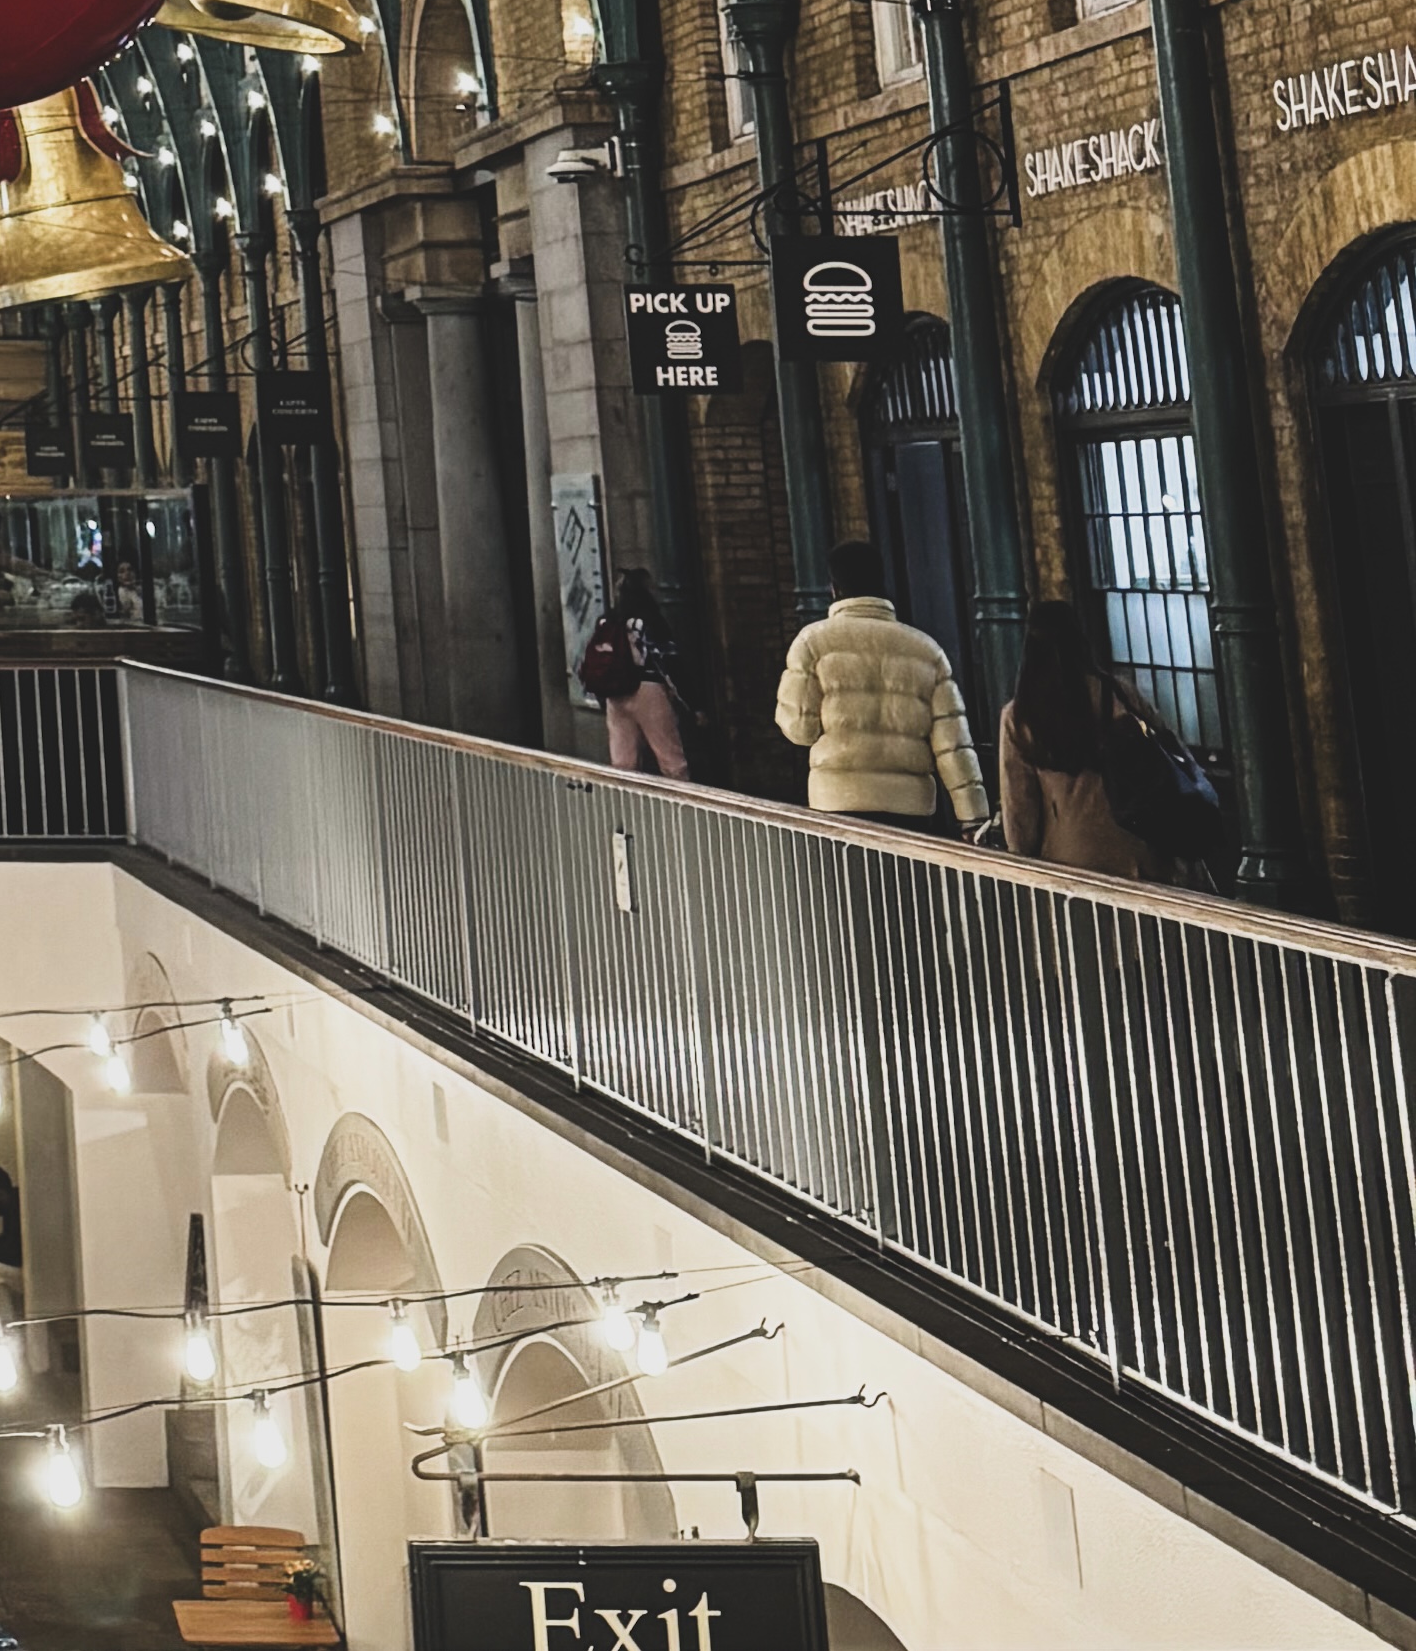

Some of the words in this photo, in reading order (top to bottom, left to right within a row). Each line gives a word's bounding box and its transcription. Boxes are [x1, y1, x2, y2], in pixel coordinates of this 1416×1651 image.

[629, 293, 689, 313] PICK
[695, 293, 731, 313] UP
[656, 366, 719, 386] HERE
[519, 1578, 722, 1651] Exit
